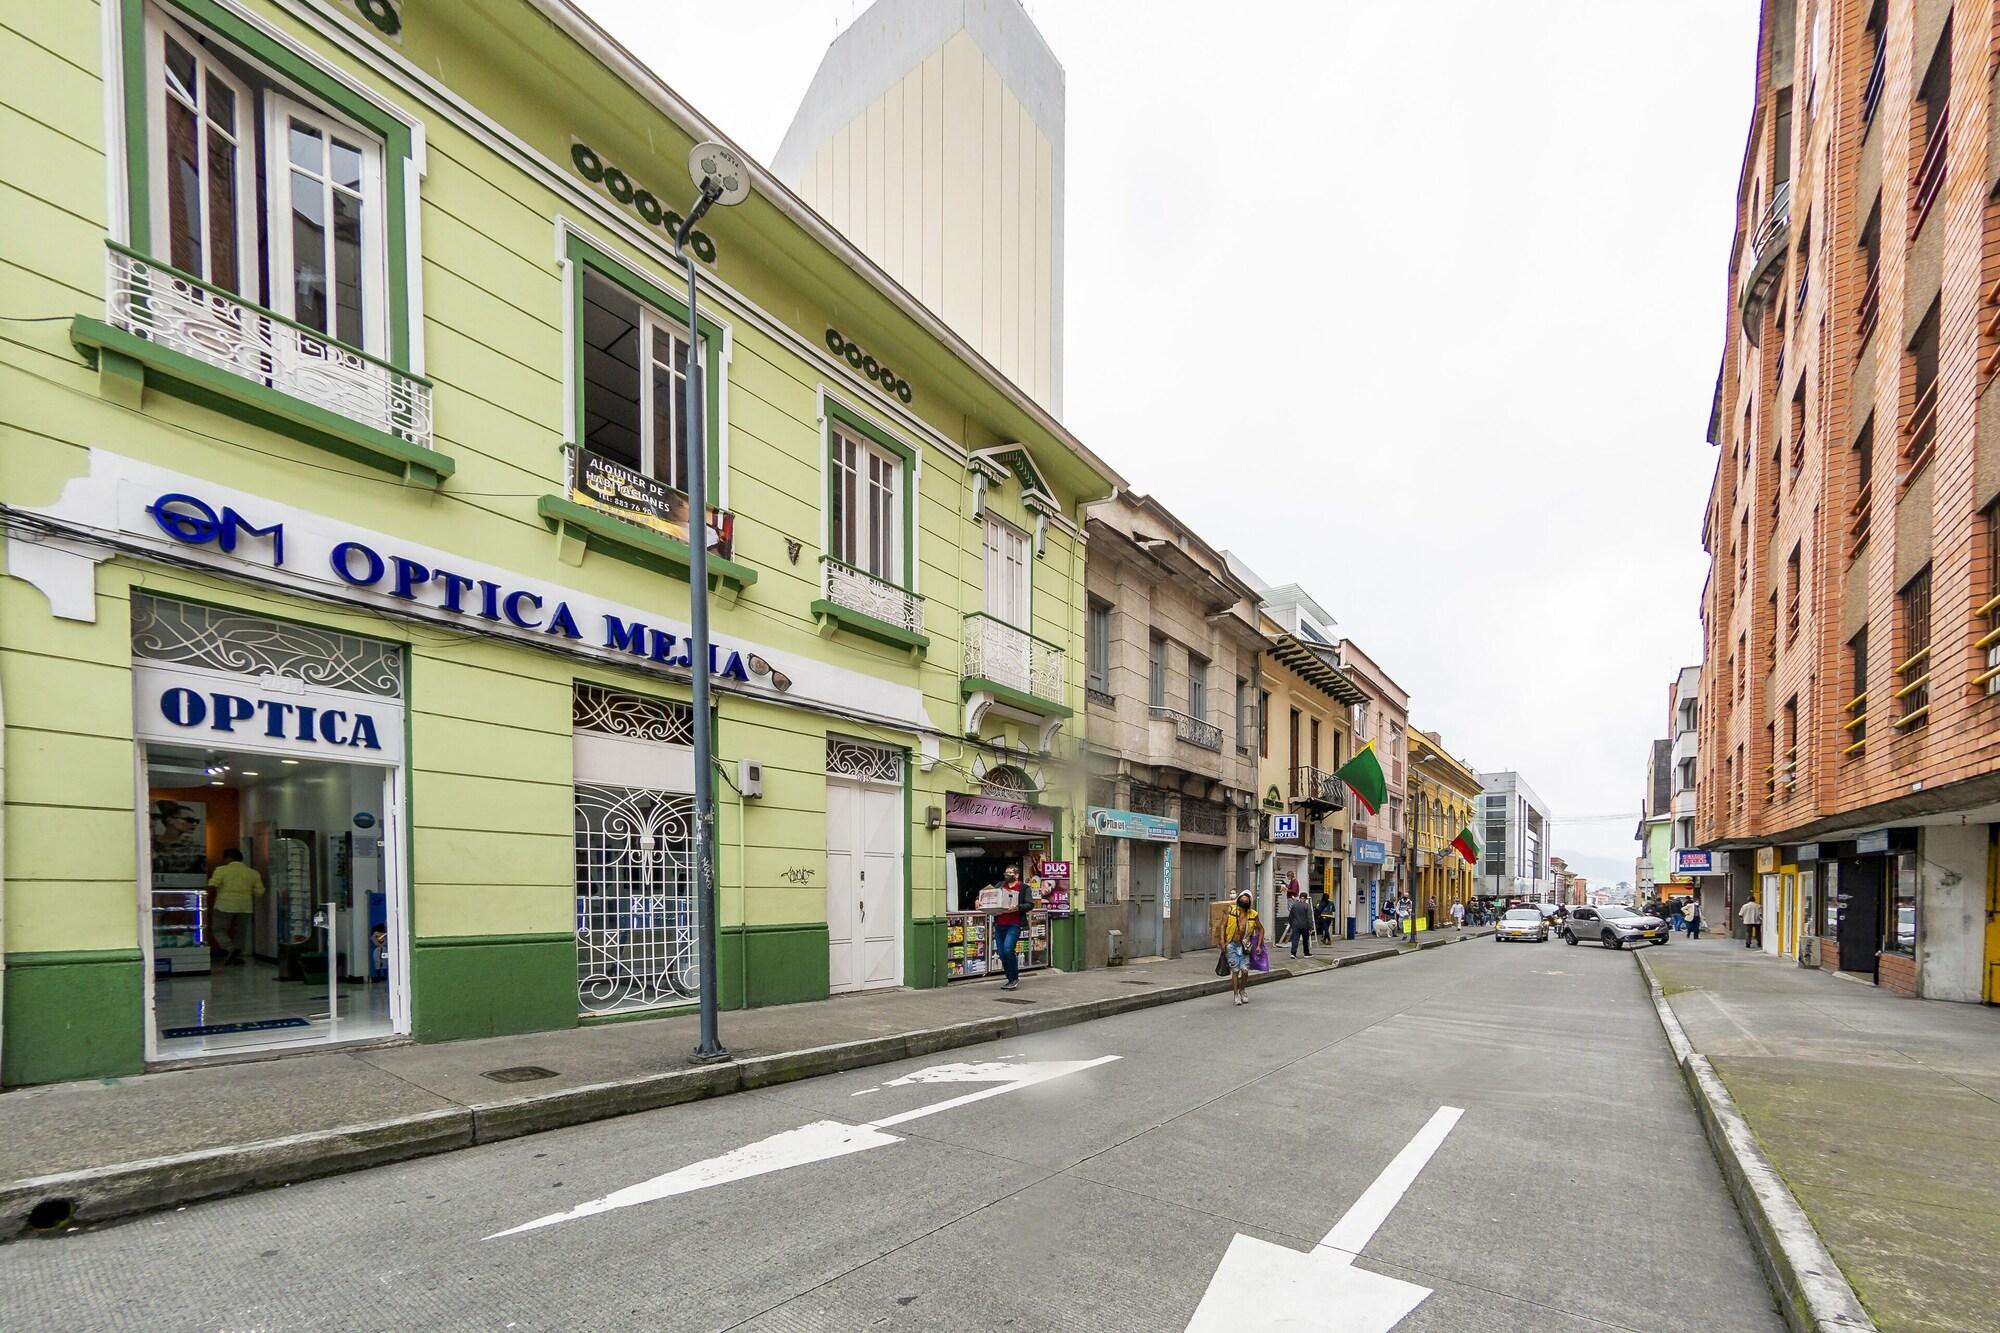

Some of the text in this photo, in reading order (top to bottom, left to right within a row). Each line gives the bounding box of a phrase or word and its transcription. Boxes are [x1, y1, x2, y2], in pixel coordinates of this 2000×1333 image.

[586, 471, 670, 513] HABITACIONES
[590, 459, 664, 496] ALQUILER DE
[330, 541, 583, 639] OPTICA
[160, 687, 382, 750] OPTICA
[1279, 817, 1292, 831] H
[1044, 863, 1067, 873] DUO
